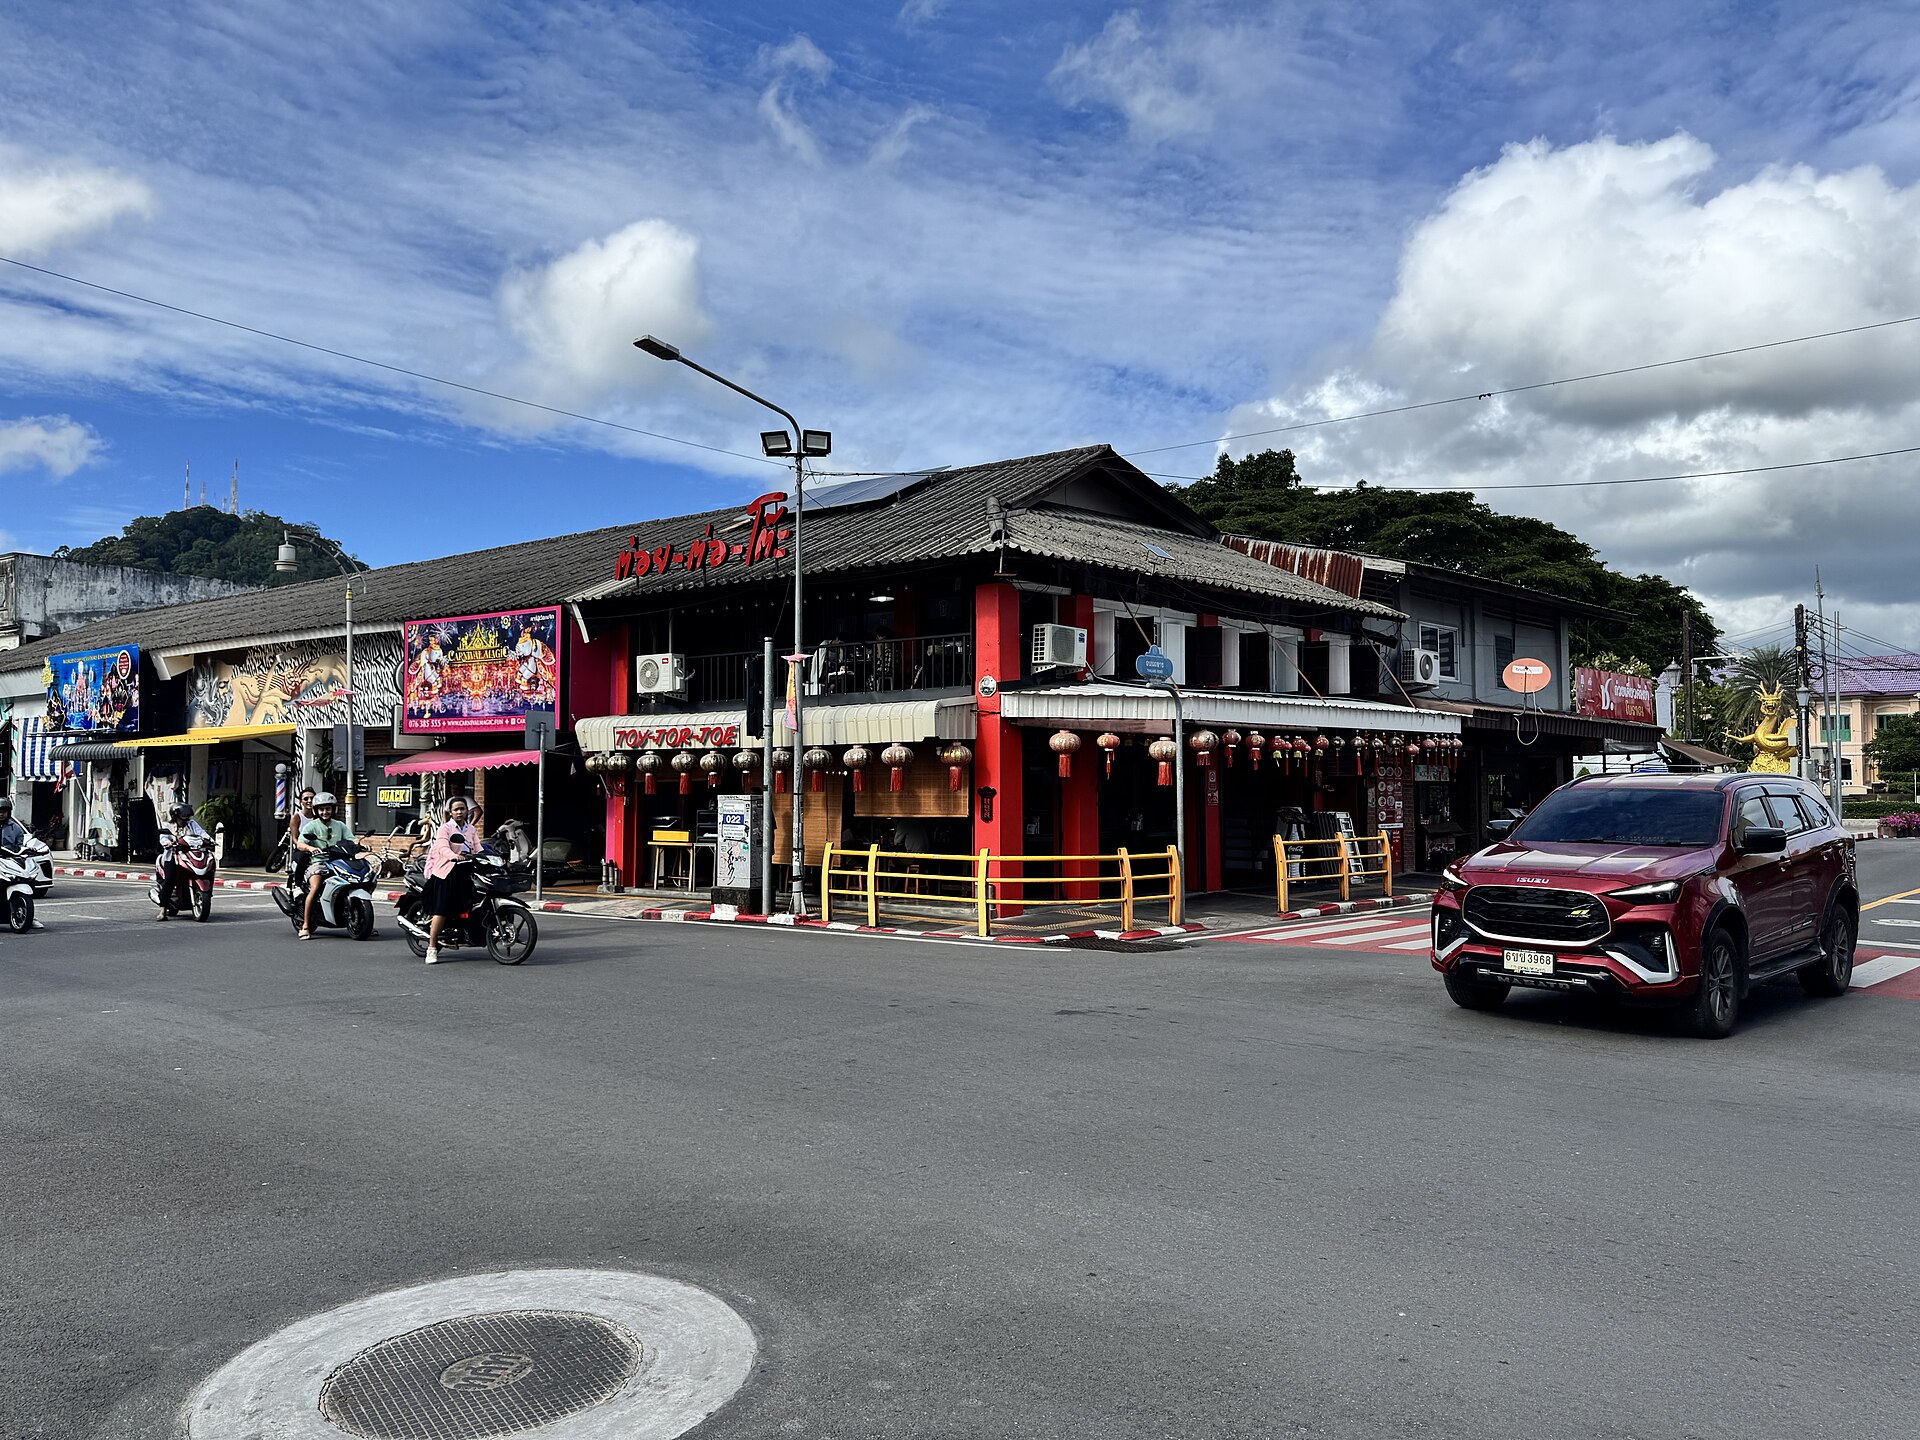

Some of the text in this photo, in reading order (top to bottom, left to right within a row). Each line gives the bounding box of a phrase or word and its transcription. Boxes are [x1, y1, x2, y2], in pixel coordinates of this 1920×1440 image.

[448, 646, 509, 663] CARNIVAL MAGIC
[408, 720, 418, 728] 076
[419, 719, 429, 728] 385
[431, 719, 441, 728] 555
[616, 726, 738, 748] TOY-TOR-TOE
[726, 815, 741, 824] 022
[1527, 953, 1551, 965] 3968
